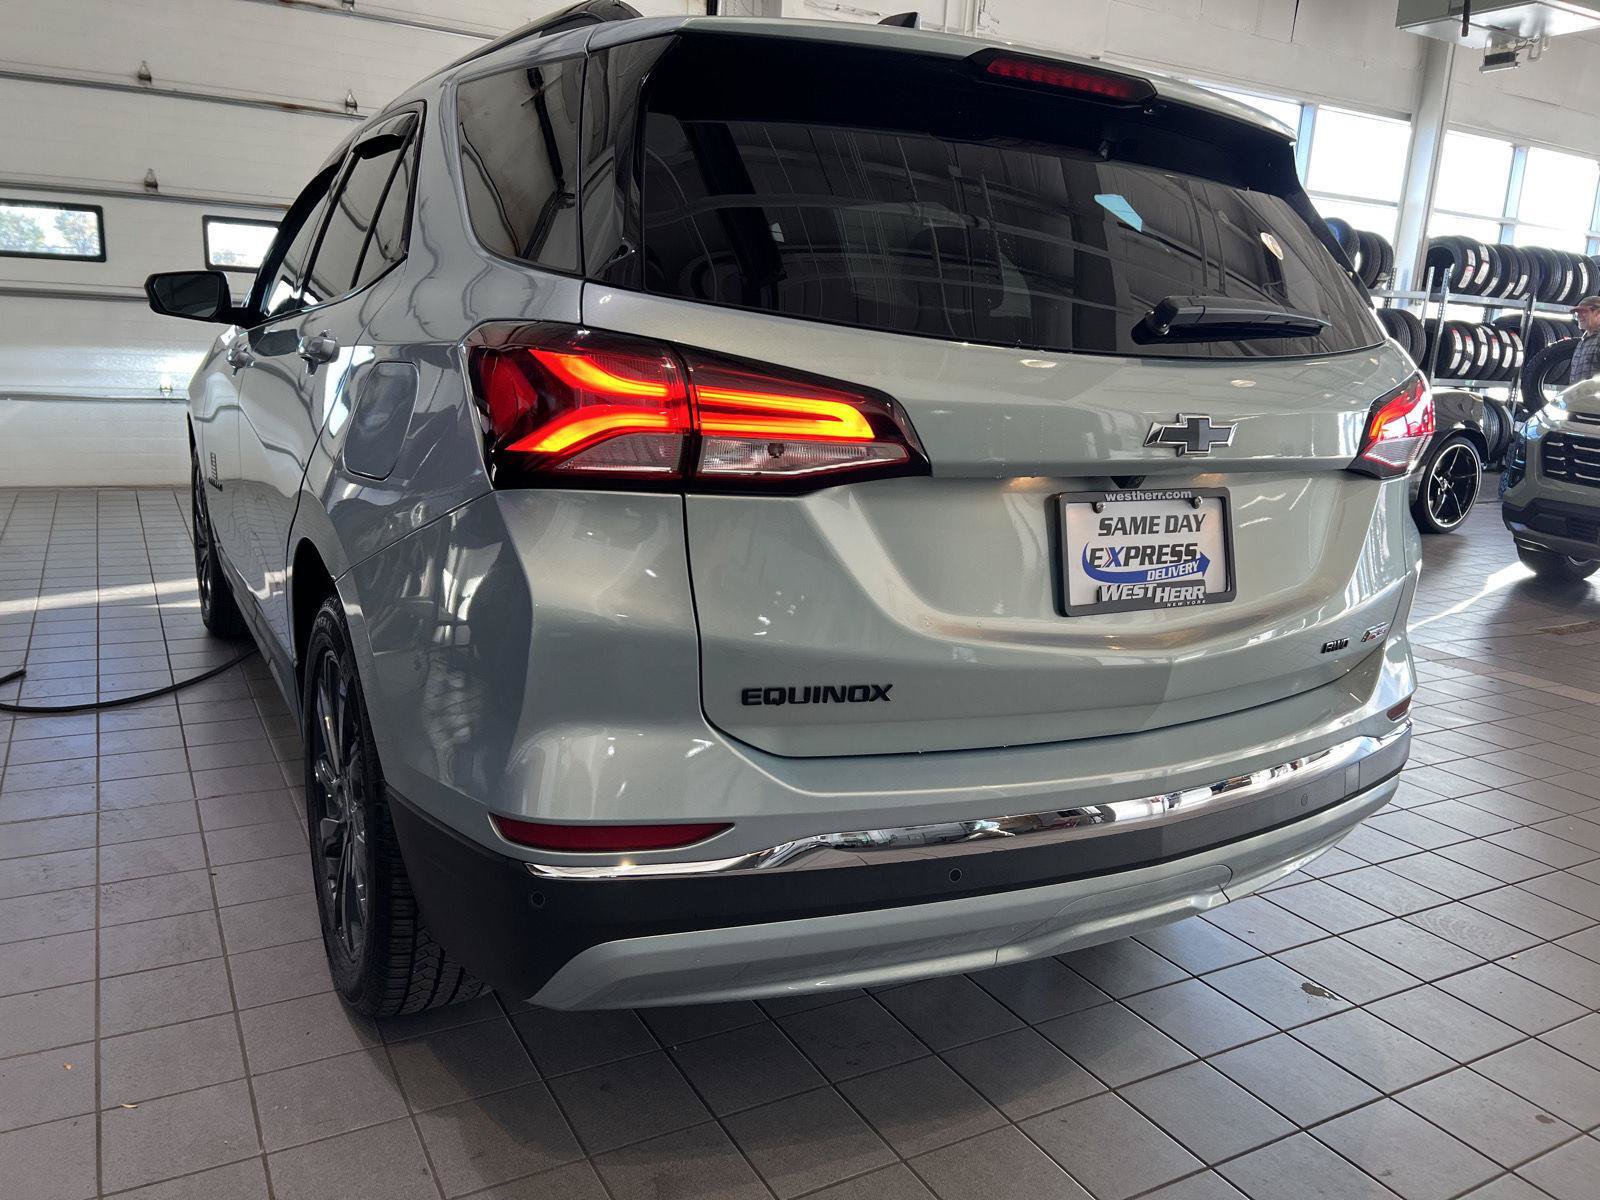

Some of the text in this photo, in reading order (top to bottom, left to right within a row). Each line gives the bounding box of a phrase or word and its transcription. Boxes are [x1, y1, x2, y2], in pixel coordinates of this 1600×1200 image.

[1105, 490, 1193, 501] westherr.com
[1098, 513, 1206, 536] SAME DAY
[1089, 542, 1198, 568] EXPRESS
[1146, 560, 1200, 581] DELIVERY
[1101, 583, 1205, 603] WEST HERR
[741, 684, 893, 706] EQUINOX
